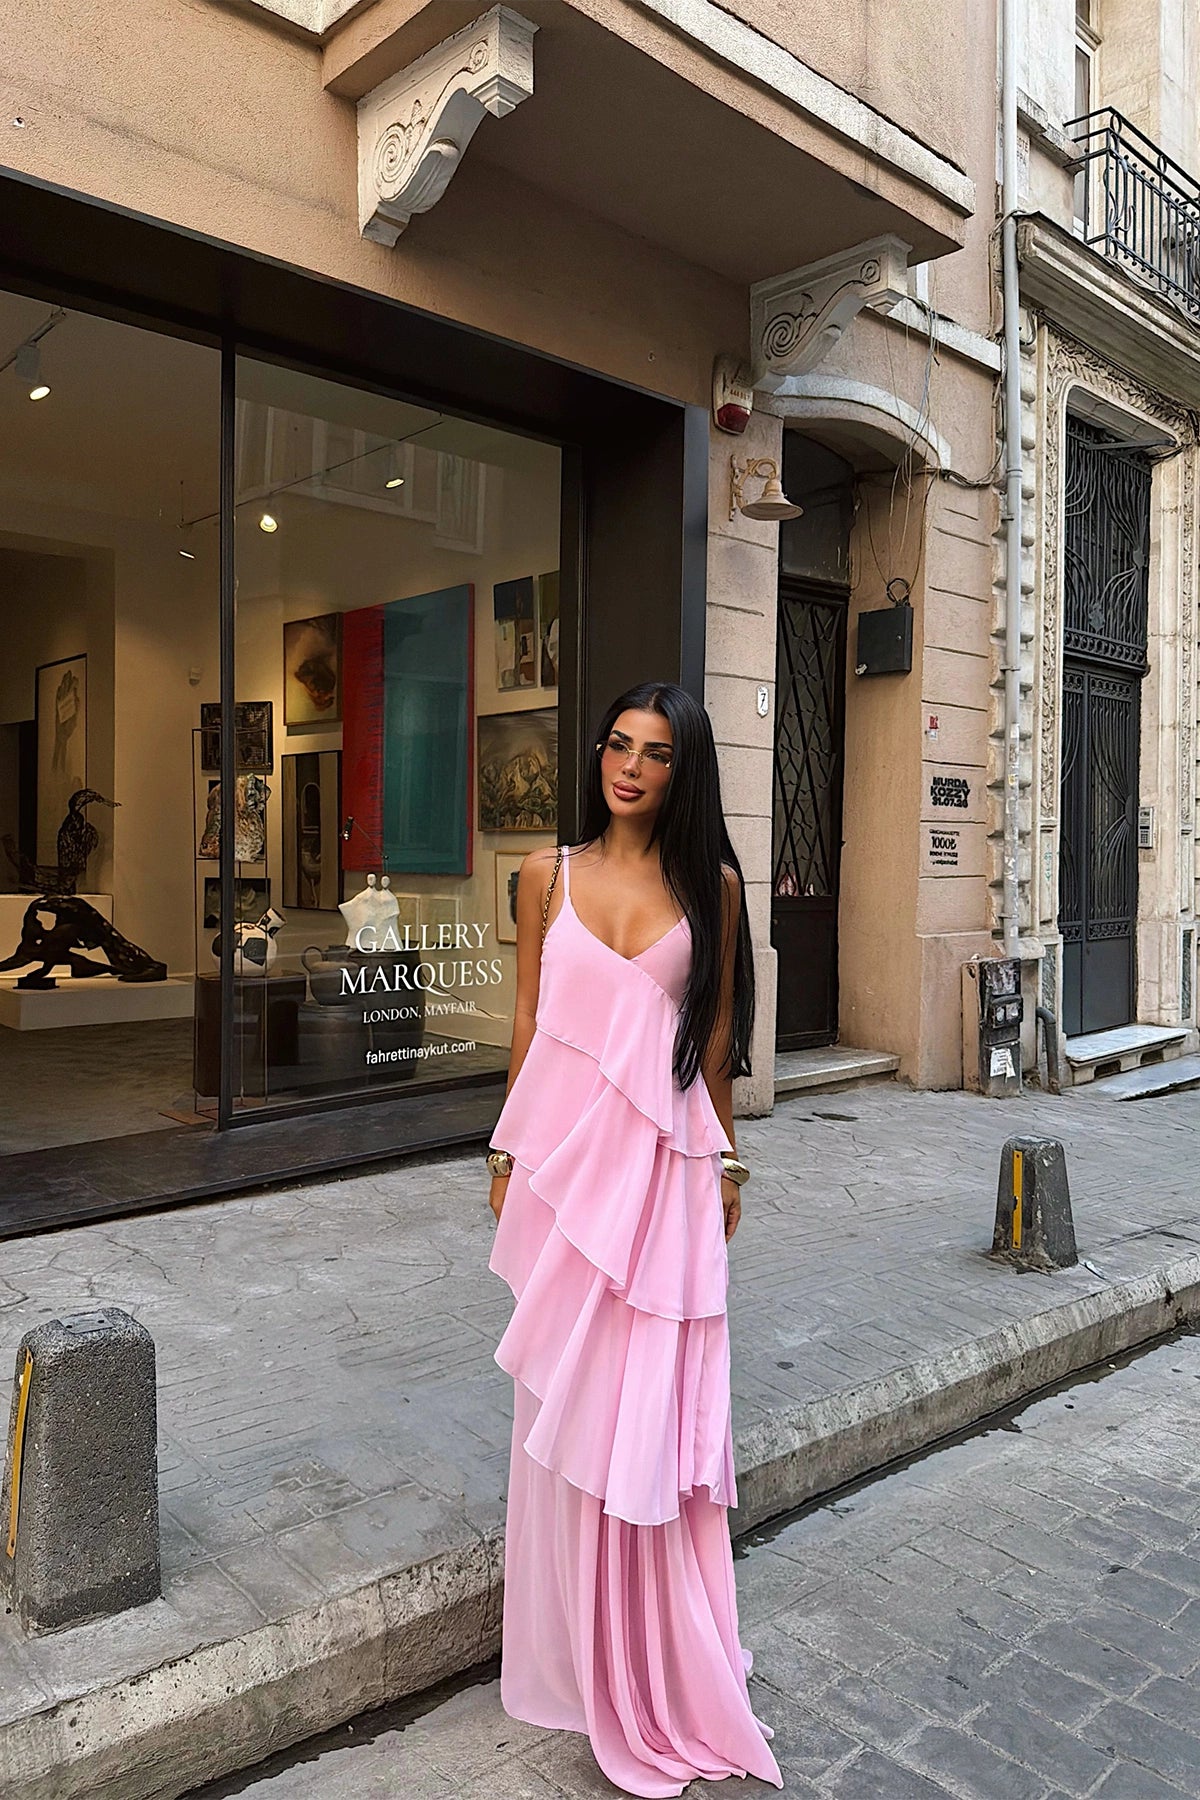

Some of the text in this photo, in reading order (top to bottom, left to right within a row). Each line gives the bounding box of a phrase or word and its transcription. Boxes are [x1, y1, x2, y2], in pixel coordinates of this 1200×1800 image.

[930, 785, 971, 800] KOZZY
[355, 923, 490, 954] GALLERY
[338, 959, 503, 997] MARQUESS
[363, 1000, 477, 1024] LONDON, MAYFAIR
[366, 1040, 476, 1065] fahrettinaykut.com
